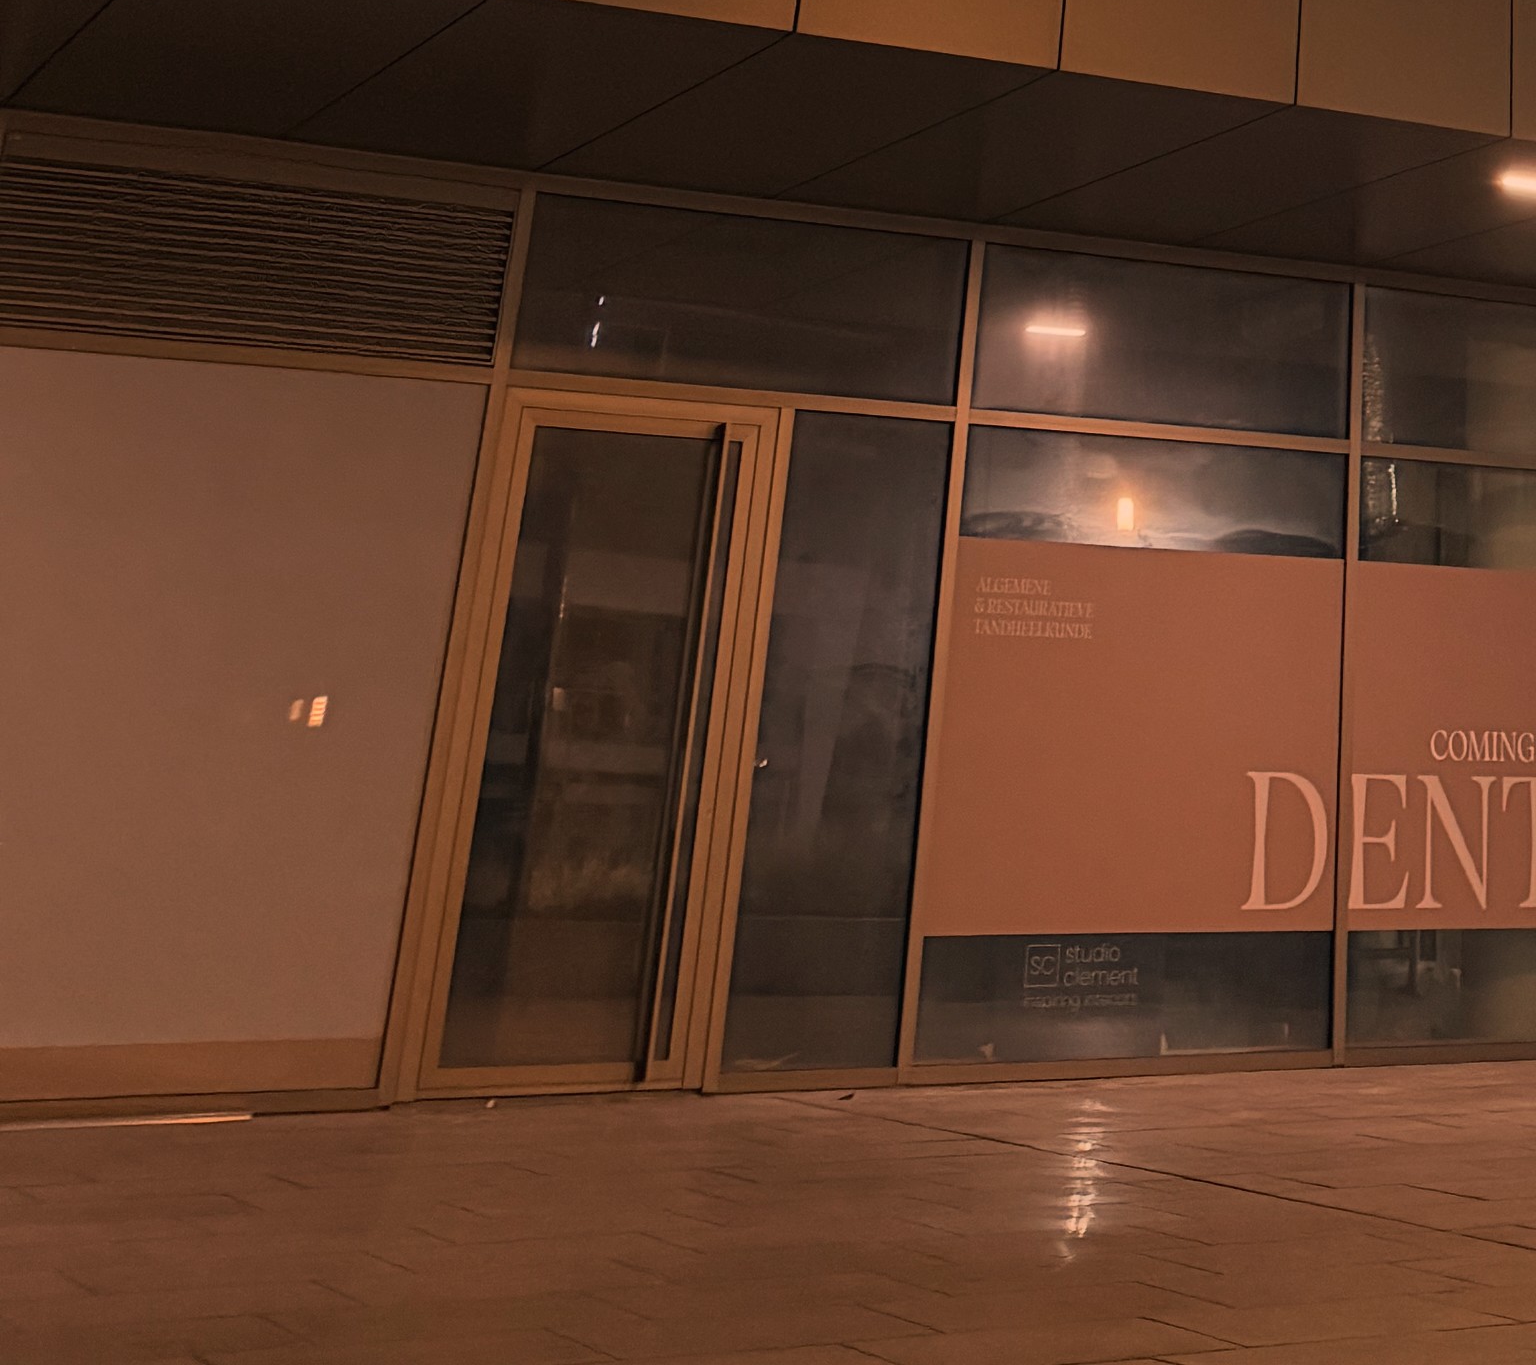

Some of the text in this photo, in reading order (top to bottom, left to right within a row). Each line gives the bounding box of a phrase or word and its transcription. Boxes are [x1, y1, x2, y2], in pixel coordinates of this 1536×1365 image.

[975, 576, 1052, 596] ALGEMENE
[973, 597, 1095, 618] & RESTAURATIEVE
[973, 618, 1094, 639] TANDHEELKUNDE
[1429, 729, 1535, 763] COMING
[1064, 942, 1121, 964] studio
[1029, 955, 1055, 976] SC
[1063, 967, 1139, 987] clement
